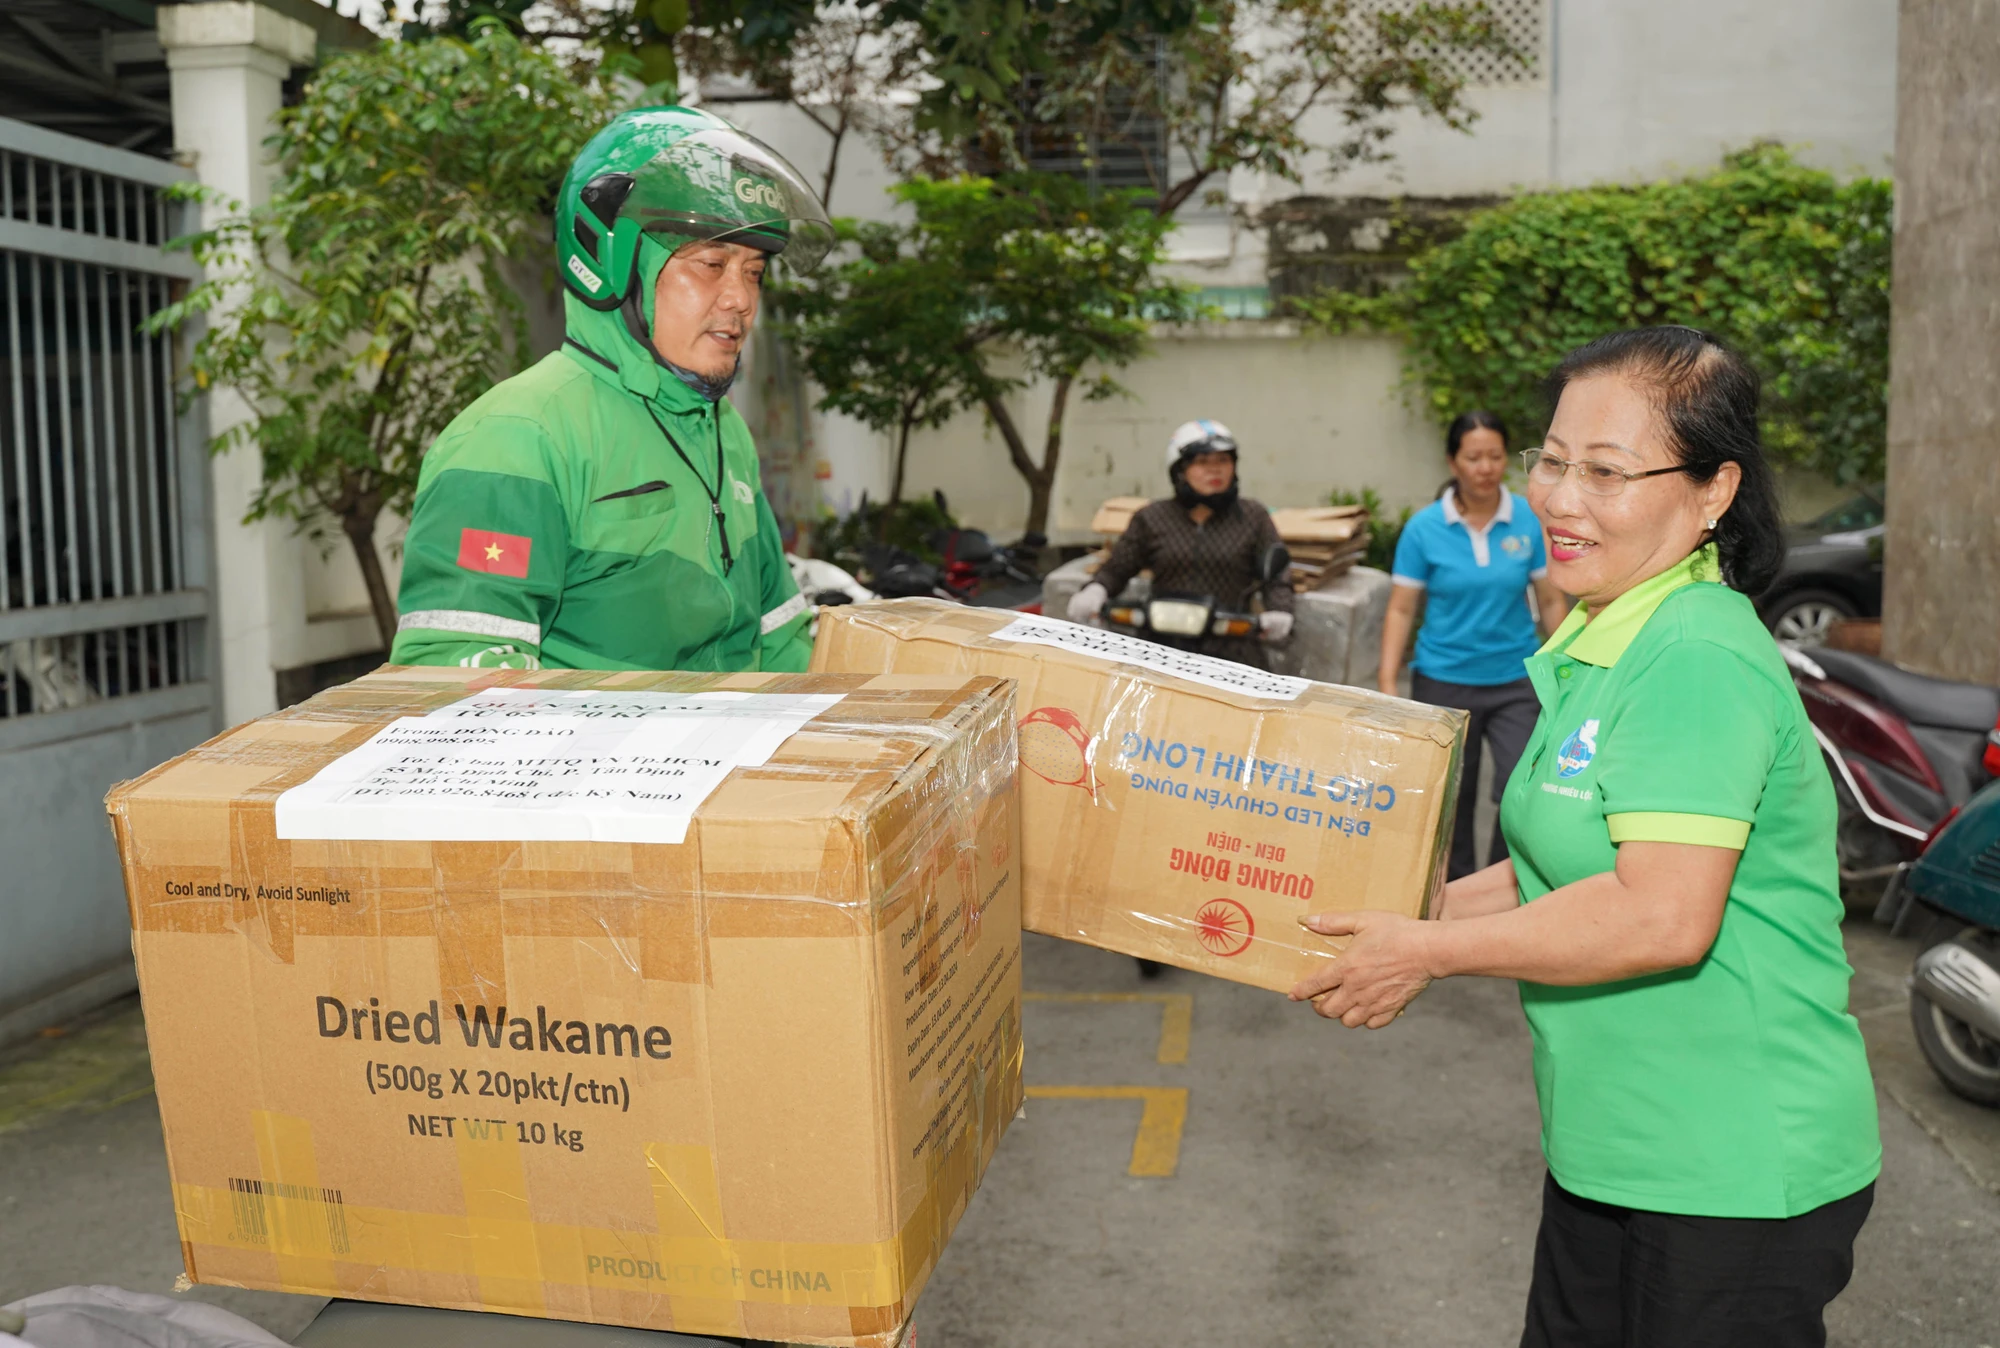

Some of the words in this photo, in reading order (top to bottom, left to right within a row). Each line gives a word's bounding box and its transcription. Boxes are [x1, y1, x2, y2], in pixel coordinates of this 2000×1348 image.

[735, 177, 786, 213] Grab
[391, 727, 448, 735] From:
[512, 758, 583, 766] MTTQ
[630, 756, 723, 767] Tp.HCM
[1119, 730, 1206, 774] LONG
[370, 777, 400, 786] Tp.
[484, 779, 539, 787] Minh
[591, 767, 628, 775] Tân
[1213, 751, 1317, 798] THANH
[622, 790, 682, 801] Nam)
[1130, 773, 1189, 798] DỤNG
[1327, 775, 1396, 812] CHO
[1193, 787, 1279, 818] CHUYÊN
[1284, 805, 1323, 828] LED
[1207, 830, 1242, 853] ĐIỆN
[1255, 842, 1286, 863] ĐÈN
[1169, 847, 1231, 881] ĐÔNG
[165, 881, 194, 897] Cool
[196, 883, 221, 898] and
[223, 882, 250, 902] Dry,
[256, 884, 293, 901] Avoid
[296, 886, 351, 905] Sunlight
[1237, 863, 1314, 900] QUANG
[316, 995, 441, 1046] Dried
[455, 1003, 672, 1061] Wakame
[366, 1061, 444, 1101] (500g
[450, 1069, 469, 1095] X
[477, 1068, 630, 1112] 20pkt/ctn)
[407, 1113, 456, 1139] NET
[461, 1118, 507, 1142] WT
[517, 1120, 547, 1145] 10
[553, 1121, 584, 1152] kg
[709, 1267, 743, 1287] OF
[750, 1268, 832, 1293] CHINA
